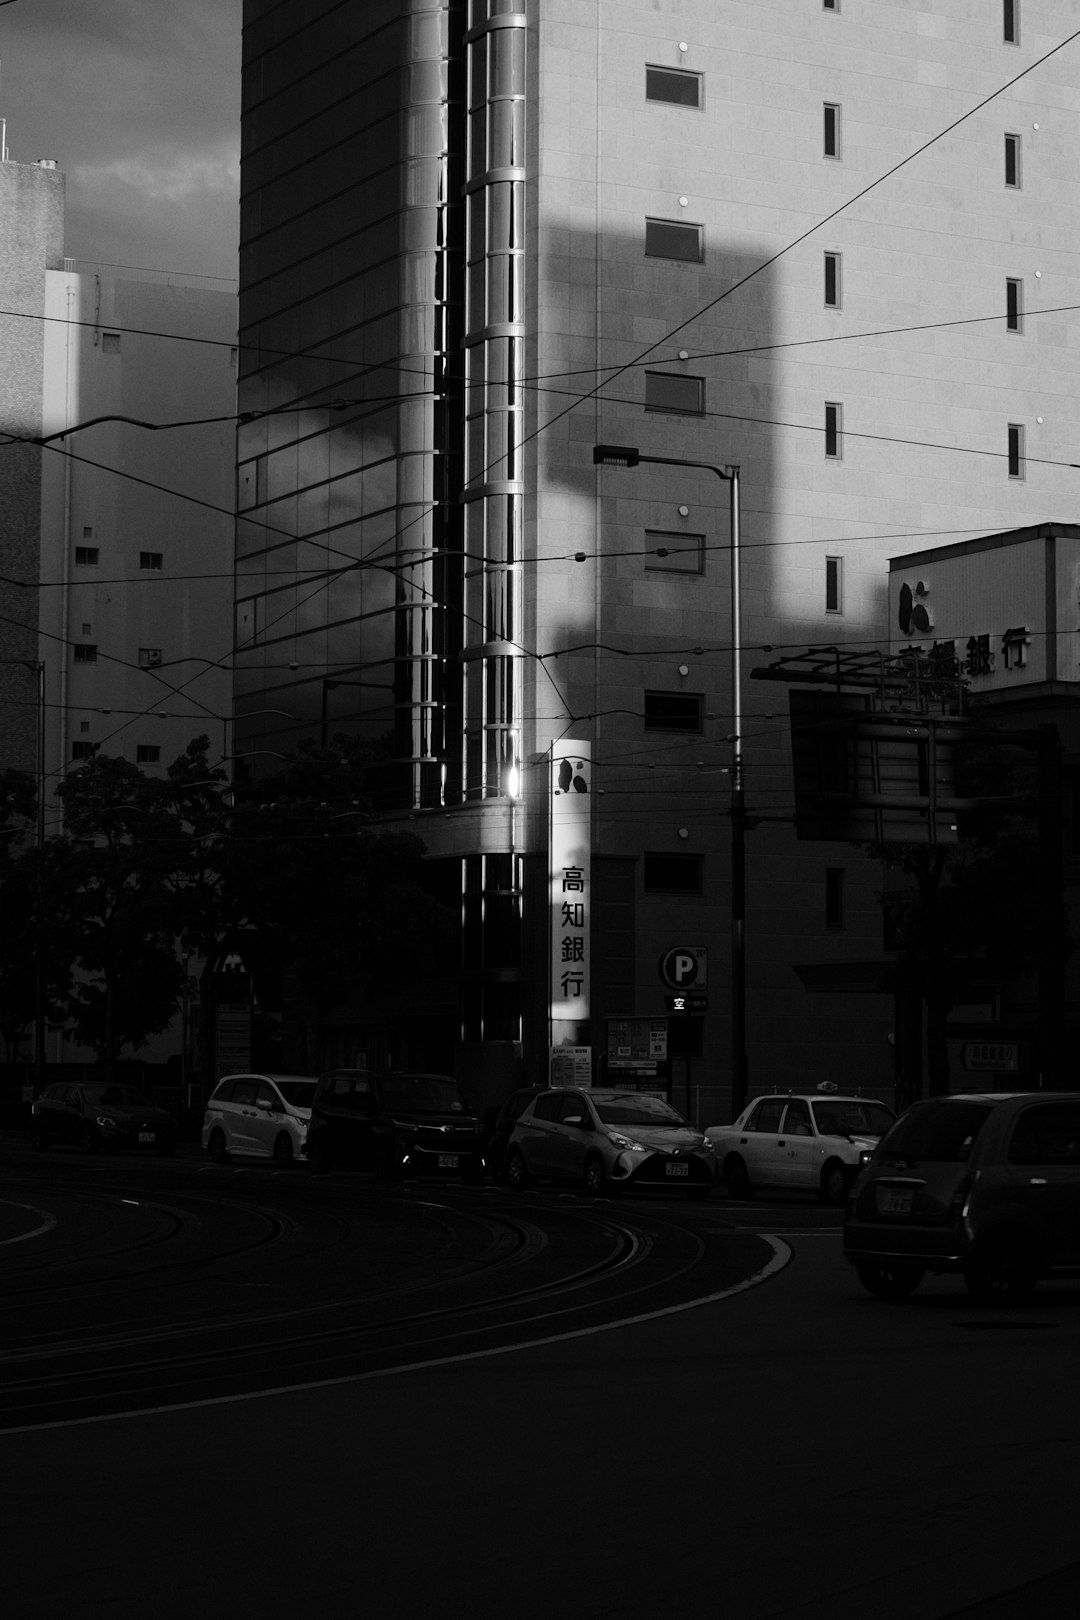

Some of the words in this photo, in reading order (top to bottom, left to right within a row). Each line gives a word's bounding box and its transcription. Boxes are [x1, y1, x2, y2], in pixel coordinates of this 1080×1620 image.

[561, 866, 585, 998] 高知銀行
[676, 955, 693, 982] P
[673, 997, 685, 1010] 空
